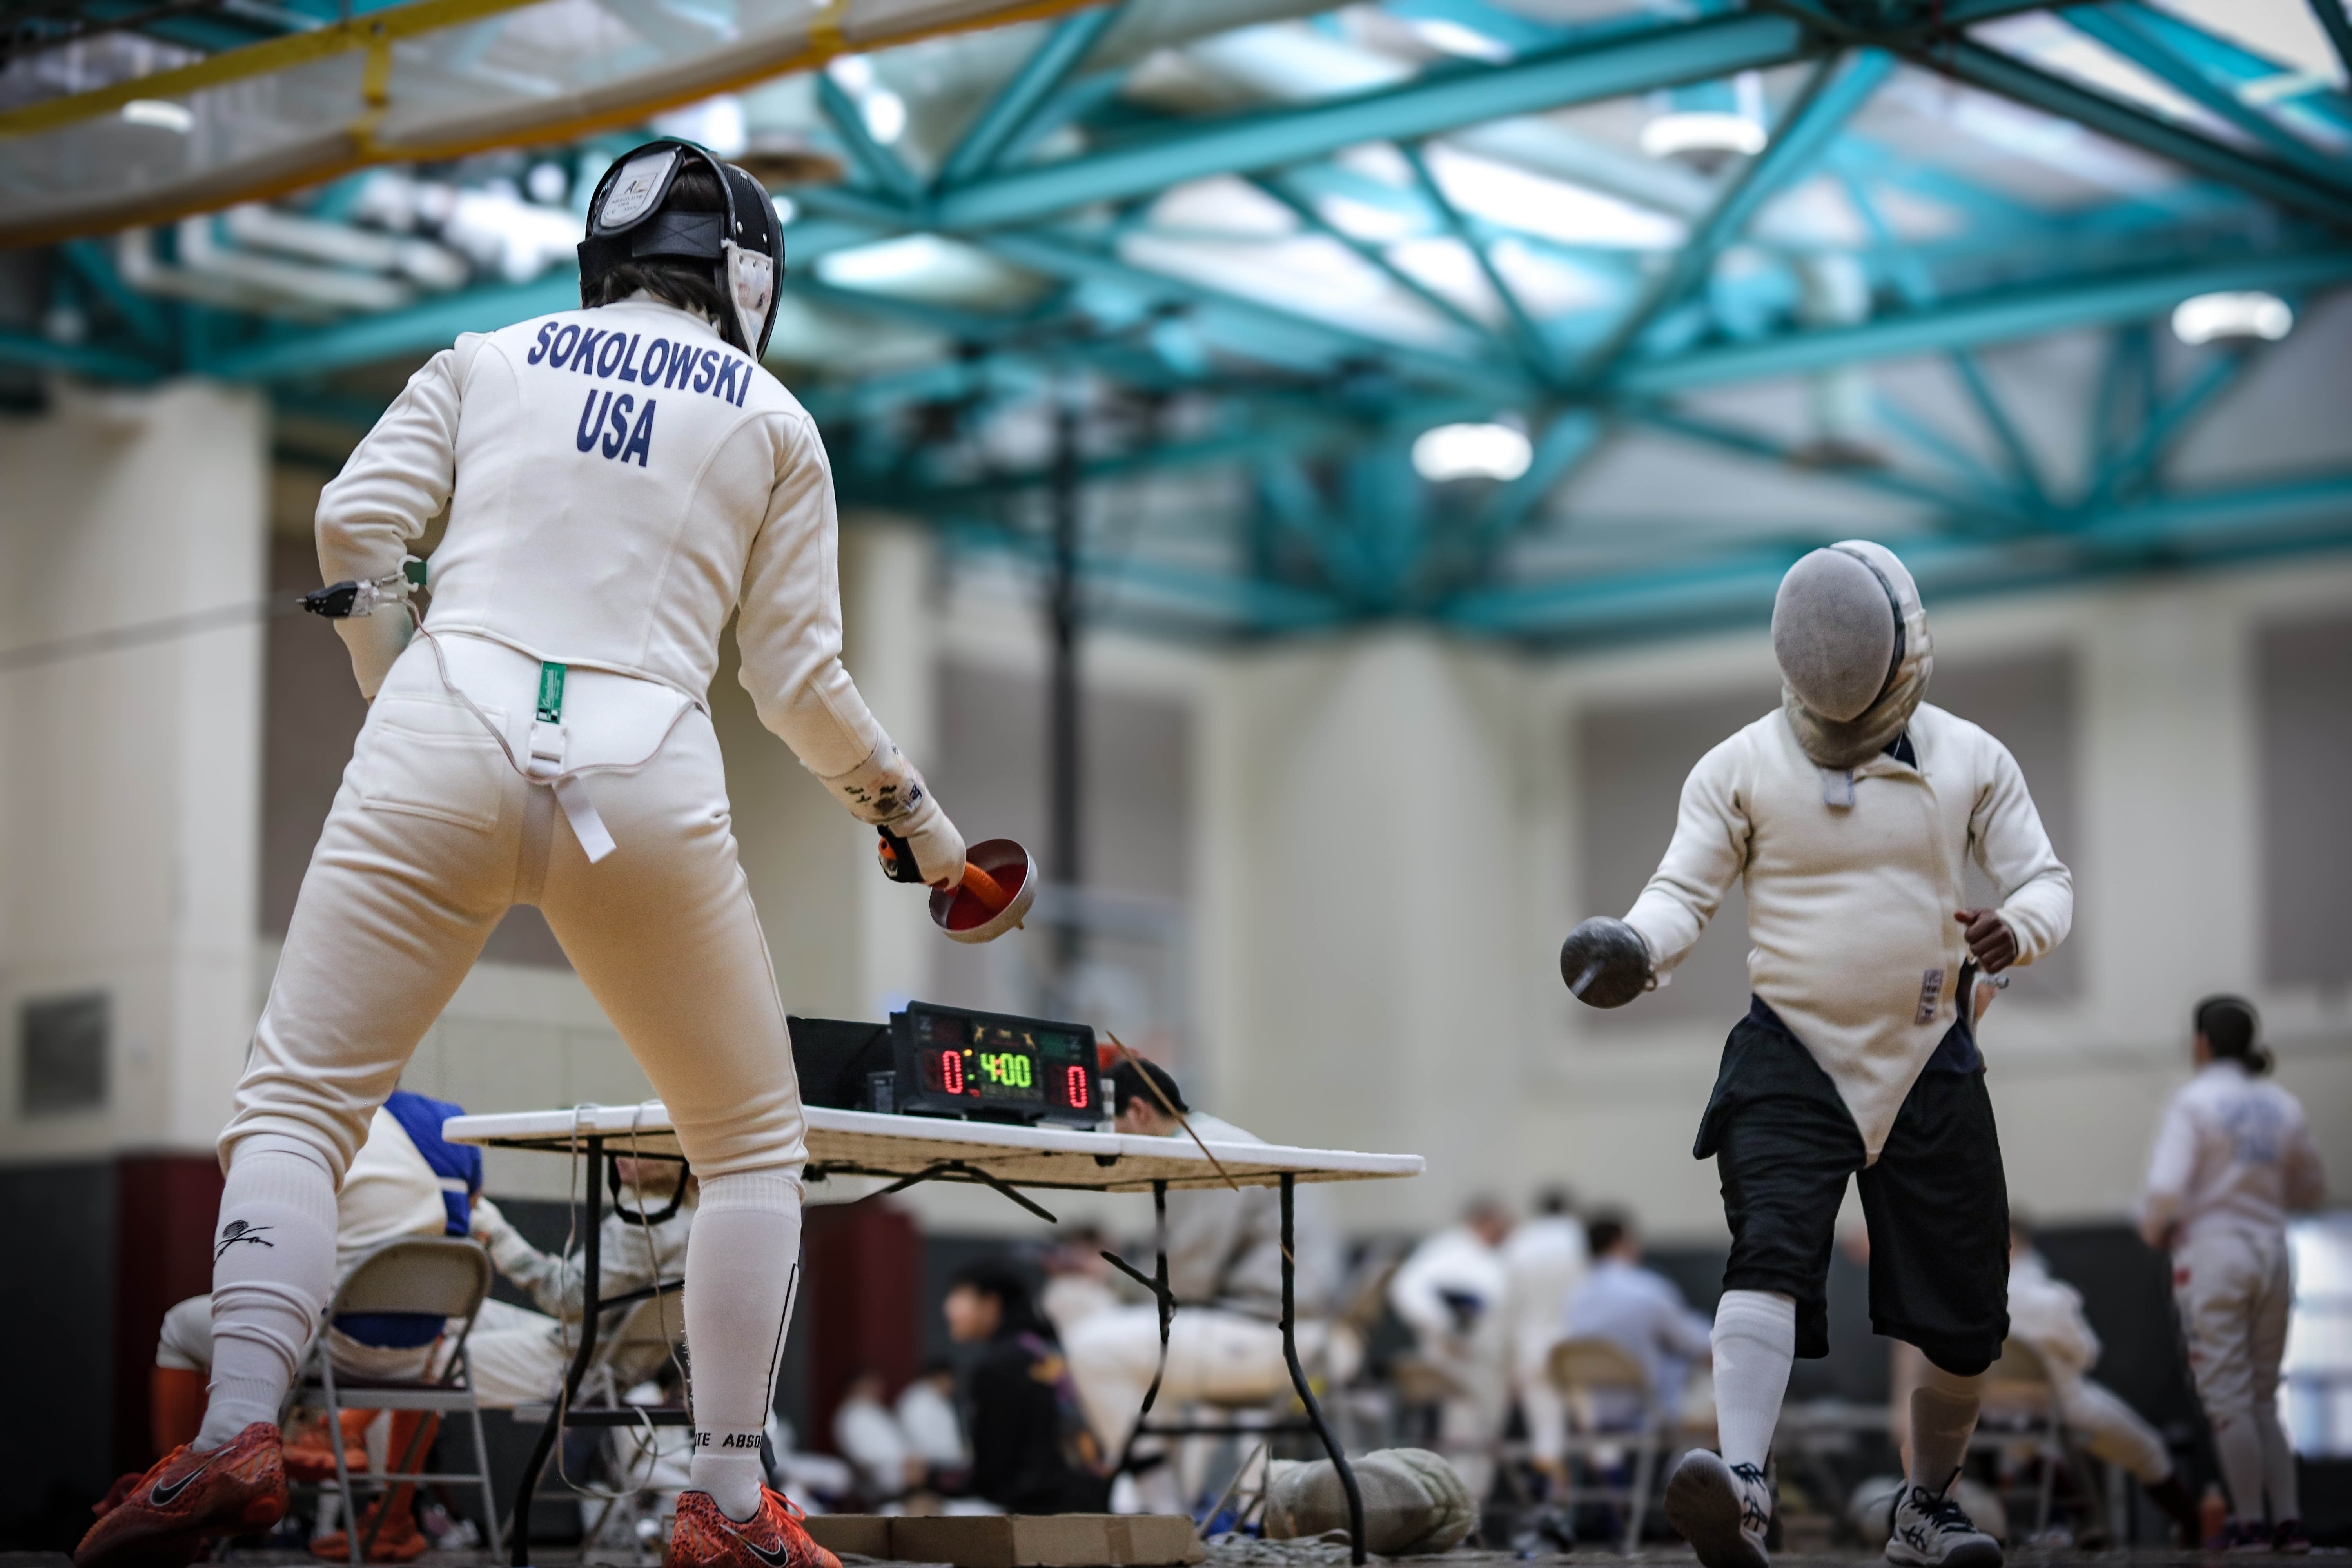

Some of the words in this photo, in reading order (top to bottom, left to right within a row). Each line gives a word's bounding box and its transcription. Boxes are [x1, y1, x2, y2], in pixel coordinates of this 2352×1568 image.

[528, 322, 753, 408] SOKOLOWSKI
[577, 389, 656, 467] USA
[942, 1051, 963, 1094] 0
[980, 1053, 1032, 1088] 4:00
[1067, 1066, 1087, 1108] 0
